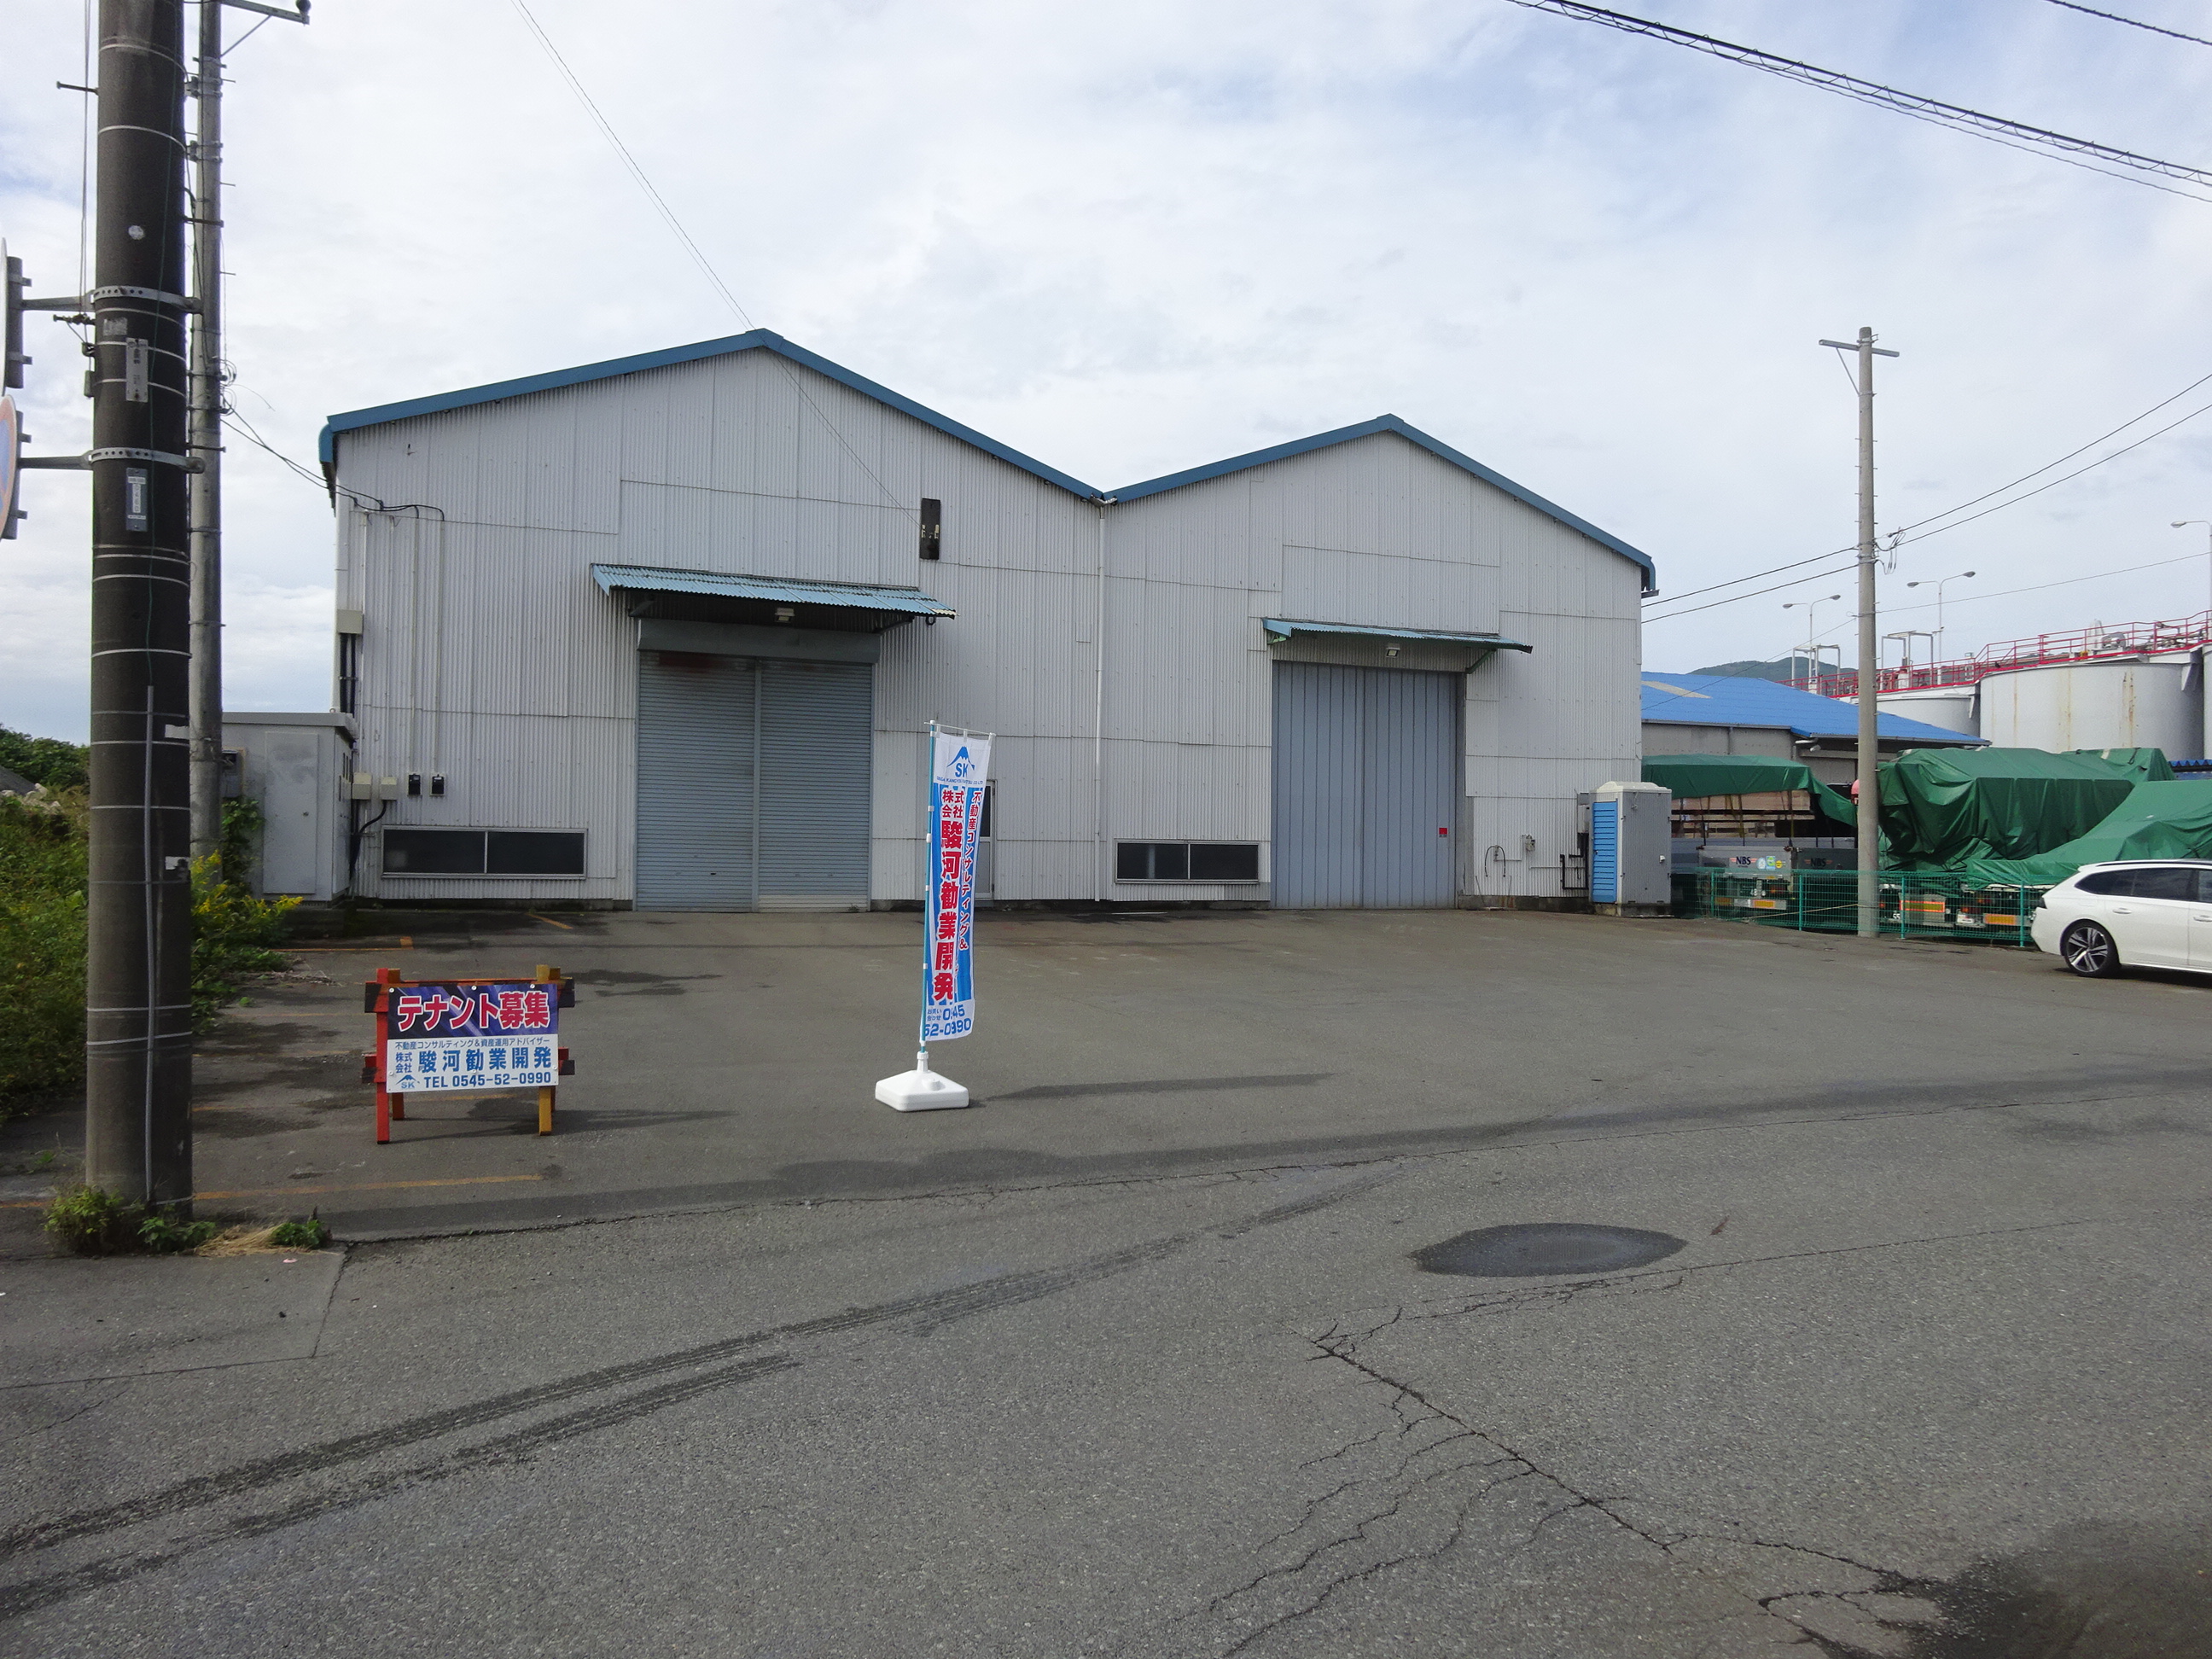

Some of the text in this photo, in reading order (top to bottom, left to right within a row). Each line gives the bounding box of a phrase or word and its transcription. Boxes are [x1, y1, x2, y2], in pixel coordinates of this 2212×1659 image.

[955, 762, 968, 777] SK
[942, 789, 963, 804] 株式
[942, 804, 963, 818] 会社
[1736, 856, 1751, 865] NBS
[1811, 858, 1826, 867] NBS
[934, 820, 963, 1000] 駿河勧業開発
[398, 991, 550, 1032] テナント募集
[395, 1052, 412, 1062] 株式
[418, 1046, 551, 1073] 駿河勧業開発
[395, 1062, 412, 1074] 会社
[424, 1072, 550, 1088] TEL 0545-52-0990
